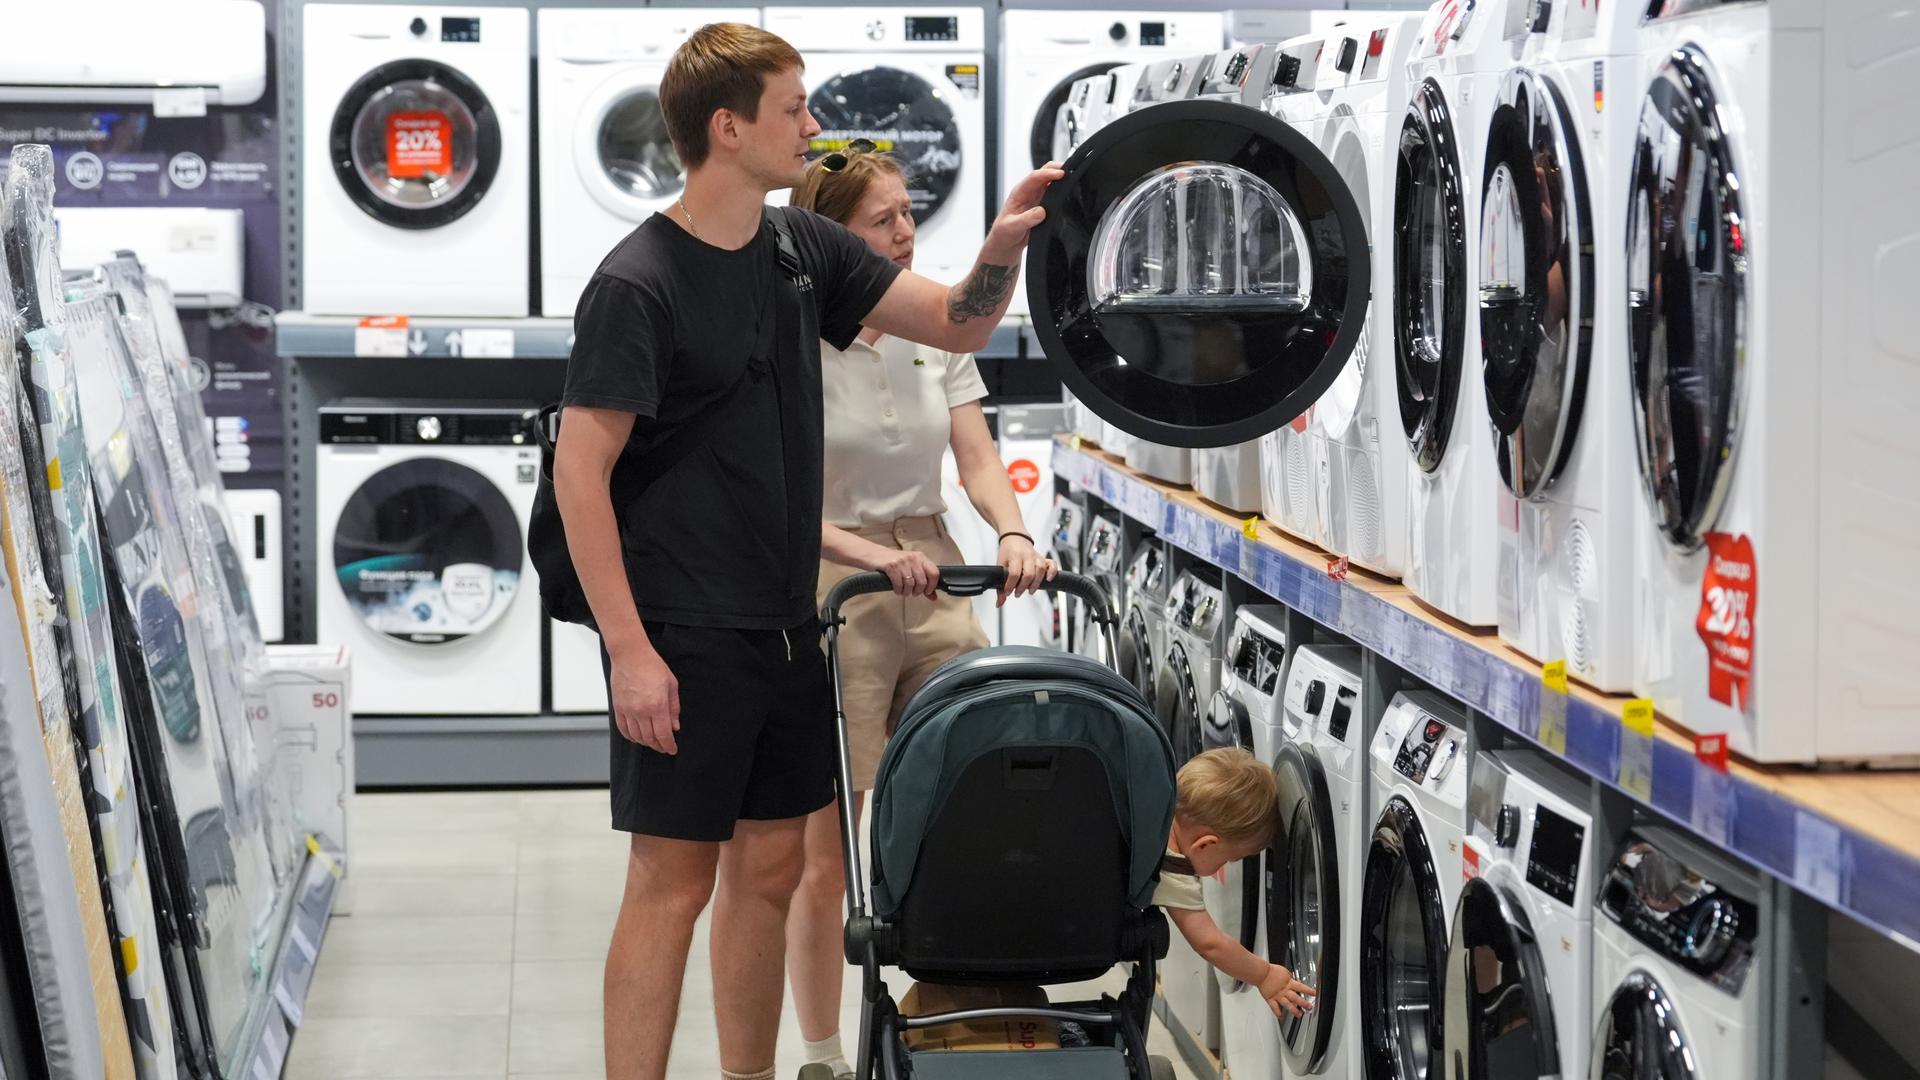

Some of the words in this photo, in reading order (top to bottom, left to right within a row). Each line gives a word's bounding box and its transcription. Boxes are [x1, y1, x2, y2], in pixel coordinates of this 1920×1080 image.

[34, 127, 55, 141] DC
[395, 130, 442, 150] 20%
[817, 128, 899, 142] НВЕРТОРНЫЙ
[901, 130, 944, 142] МОТОР
[1706, 587, 1750, 638] 20%
[312, 692, 338, 708] 50
[1019, 1022, 1036, 1048] Sup
